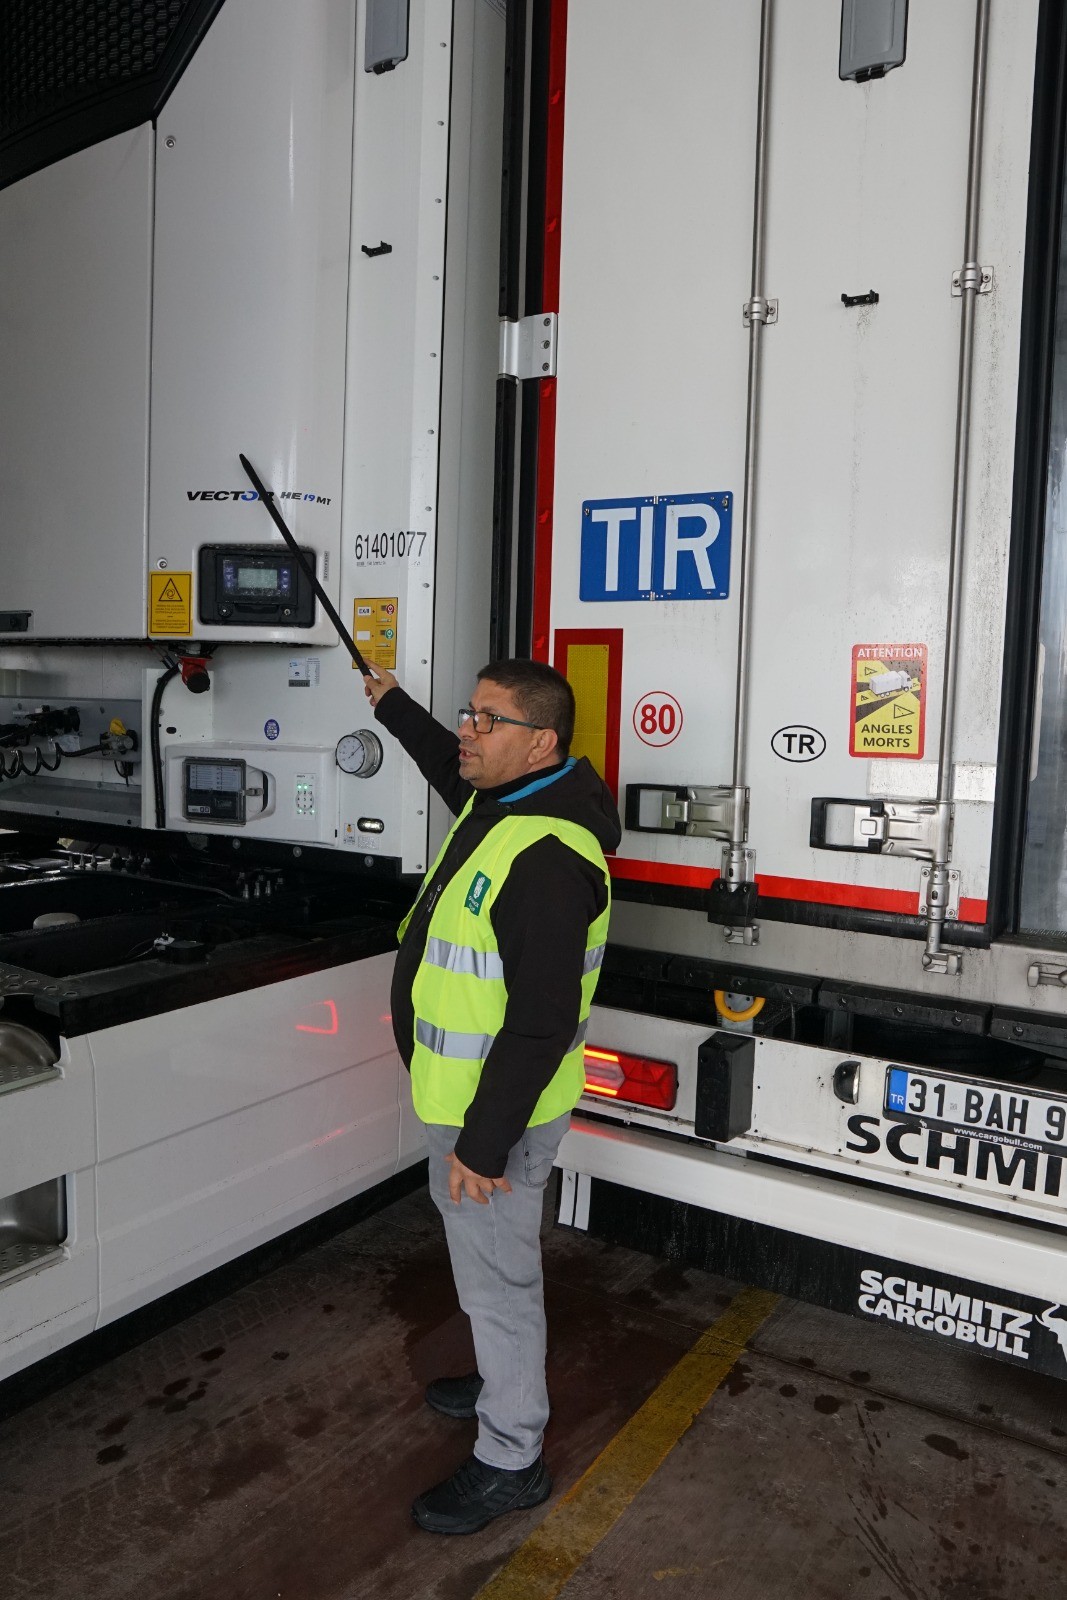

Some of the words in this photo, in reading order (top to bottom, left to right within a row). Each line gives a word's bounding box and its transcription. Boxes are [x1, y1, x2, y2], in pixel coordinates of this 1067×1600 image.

[280, 491, 302, 500] HE
[303, 494, 316, 502] 19
[316, 496, 332, 506] MT
[355, 530, 427, 560] 61401077
[591, 503, 721, 592] TIR
[857, 646, 923, 659] ATTENTION
[640, 703, 676, 735] 80
[861, 723, 913, 736] ANGLES
[782, 733, 816, 755] TR
[863, 737, 910, 749] MORTS
[890, 1092, 904, 1106] TR
[908, 1078, 946, 1117] 31
[963, 1088, 1029, 1135] BAH
[1044, 1105, 1067, 1142] 9
[953, 1126, 1043, 1151] www.cargobull.com
[859, 1269, 1034, 1338] SCHMITZ
[858, 1293, 1029, 1360] CARGOBULL
